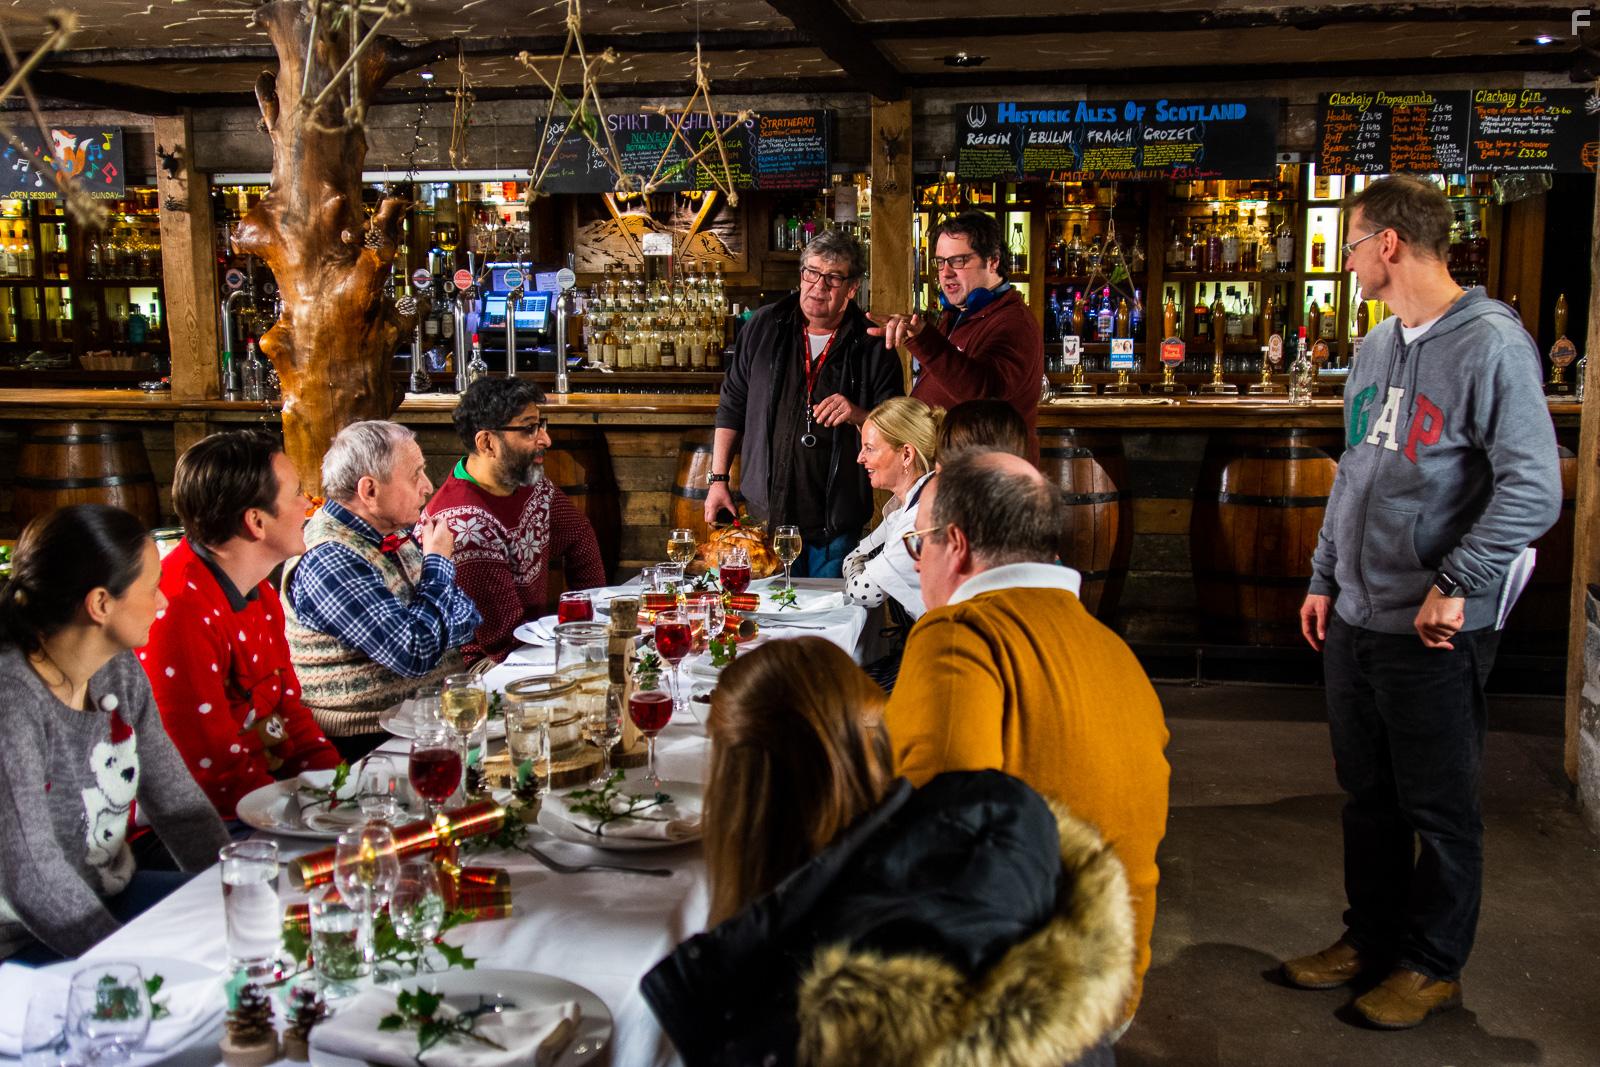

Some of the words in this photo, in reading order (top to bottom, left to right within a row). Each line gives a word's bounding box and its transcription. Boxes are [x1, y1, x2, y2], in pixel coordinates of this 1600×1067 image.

[1329, 92, 1373, 112] Clachaig
[1376, 91, 1433, 109] Propaganda
[1475, 90, 1517, 108] Clachaig
[1520, 89, 1541, 108] Gin
[1075, 99, 1117, 122] ALES
[1155, 99, 1247, 122] SCOTLAND
[1518, 148, 1548, 158] £32.50
[9, 191, 28, 200] OPEN
[29, 191, 57, 200] SESSION
[91, 191, 119, 200] SUNDAY
[1349, 382, 1445, 465] GAP
